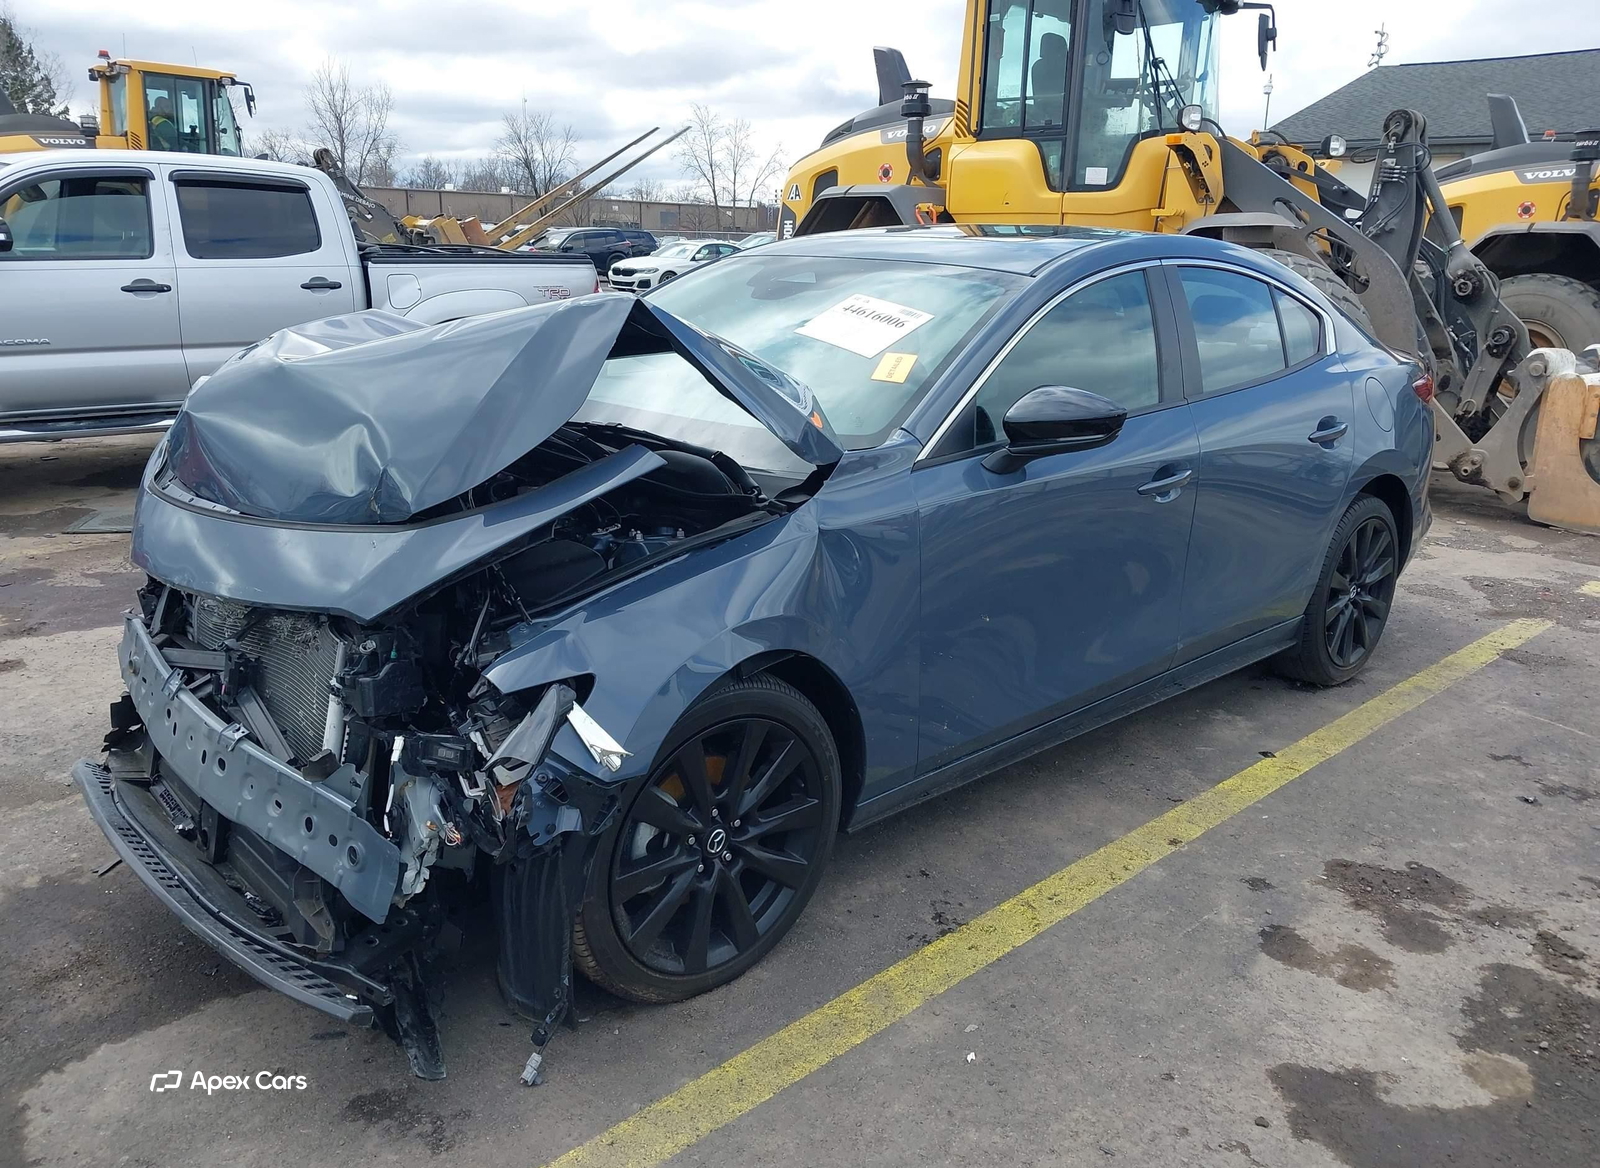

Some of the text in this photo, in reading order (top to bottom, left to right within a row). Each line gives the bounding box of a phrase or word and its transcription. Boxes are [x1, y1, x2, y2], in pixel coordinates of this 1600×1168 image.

[1523, 168, 1576, 179] VOLV
[537, 288, 571, 300] TRD
[842, 304, 910, 328] 44616006
[0, 338, 51, 346] COMA
[886, 356, 904, 379] DETAILED
